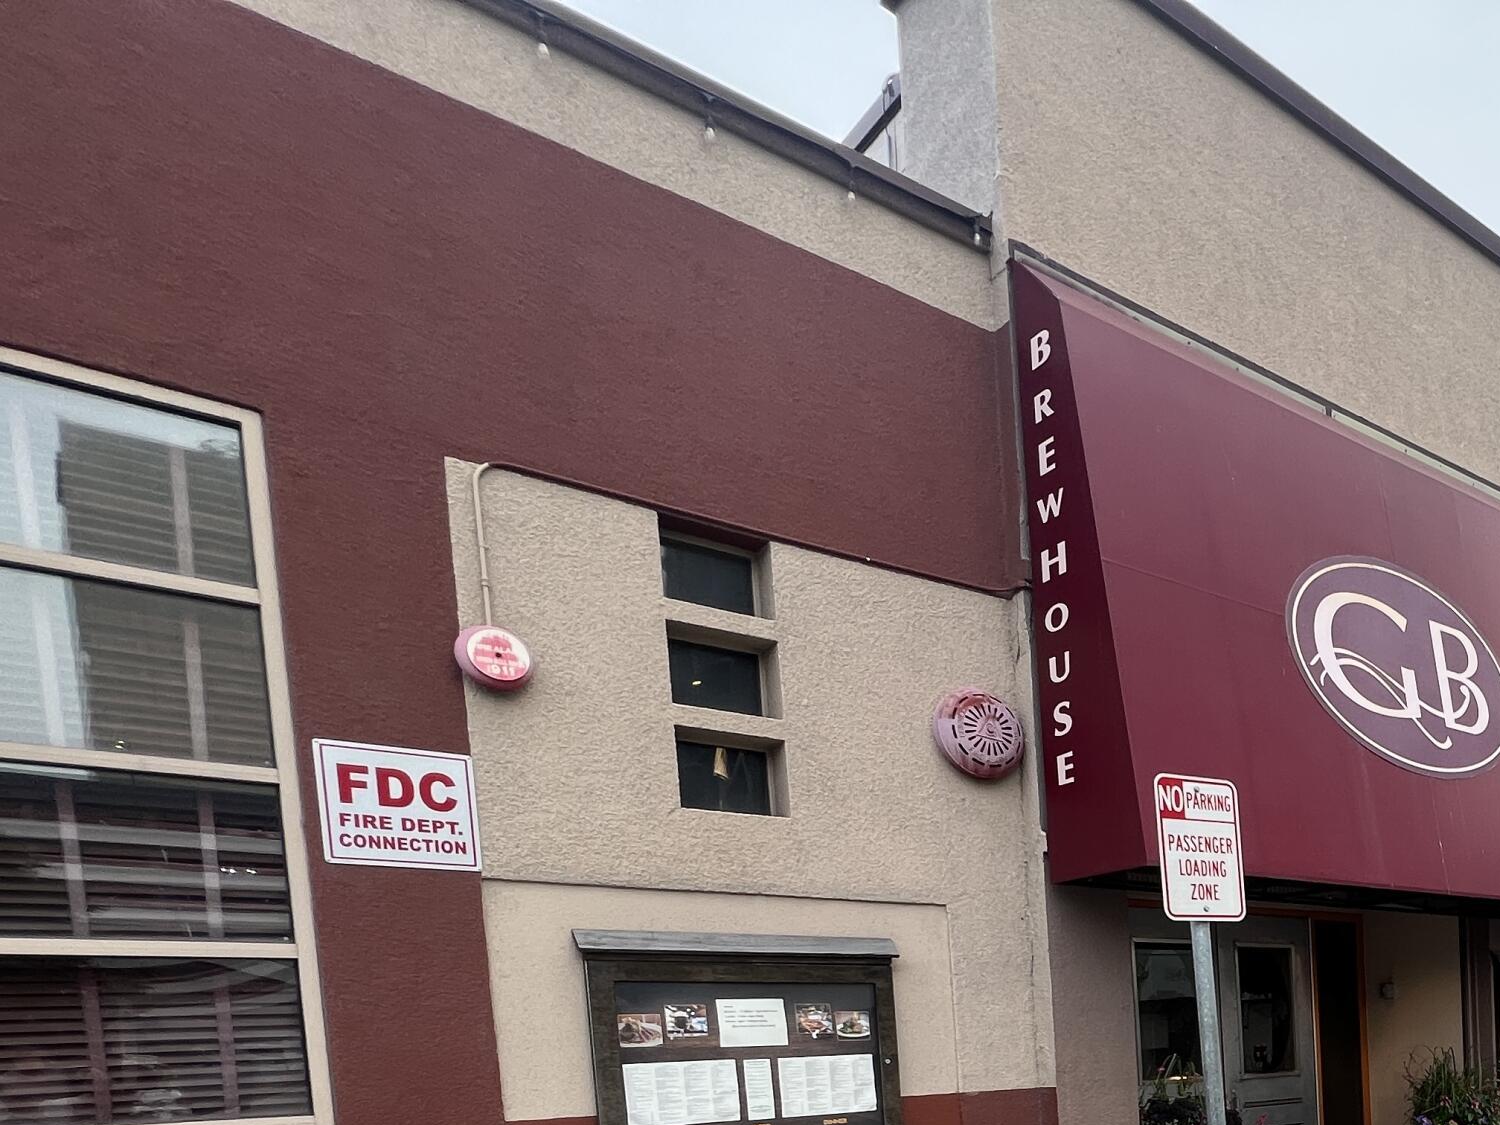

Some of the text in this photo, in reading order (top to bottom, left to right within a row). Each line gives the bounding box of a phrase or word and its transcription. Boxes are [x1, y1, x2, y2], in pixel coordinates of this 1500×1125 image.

[1029, 328, 1076, 787] BREWHOUSE
[336, 763, 458, 813] FDC
[1158, 784, 1231, 813] NO PARKING
[339, 812, 464, 836] FIRE DEPT.
[339, 833, 467, 855] CONNECTION
[1168, 834, 1233, 855] PASSENGER
[1178, 858, 1227, 878] LOADING
[1191, 883, 1220, 901] ZONE
